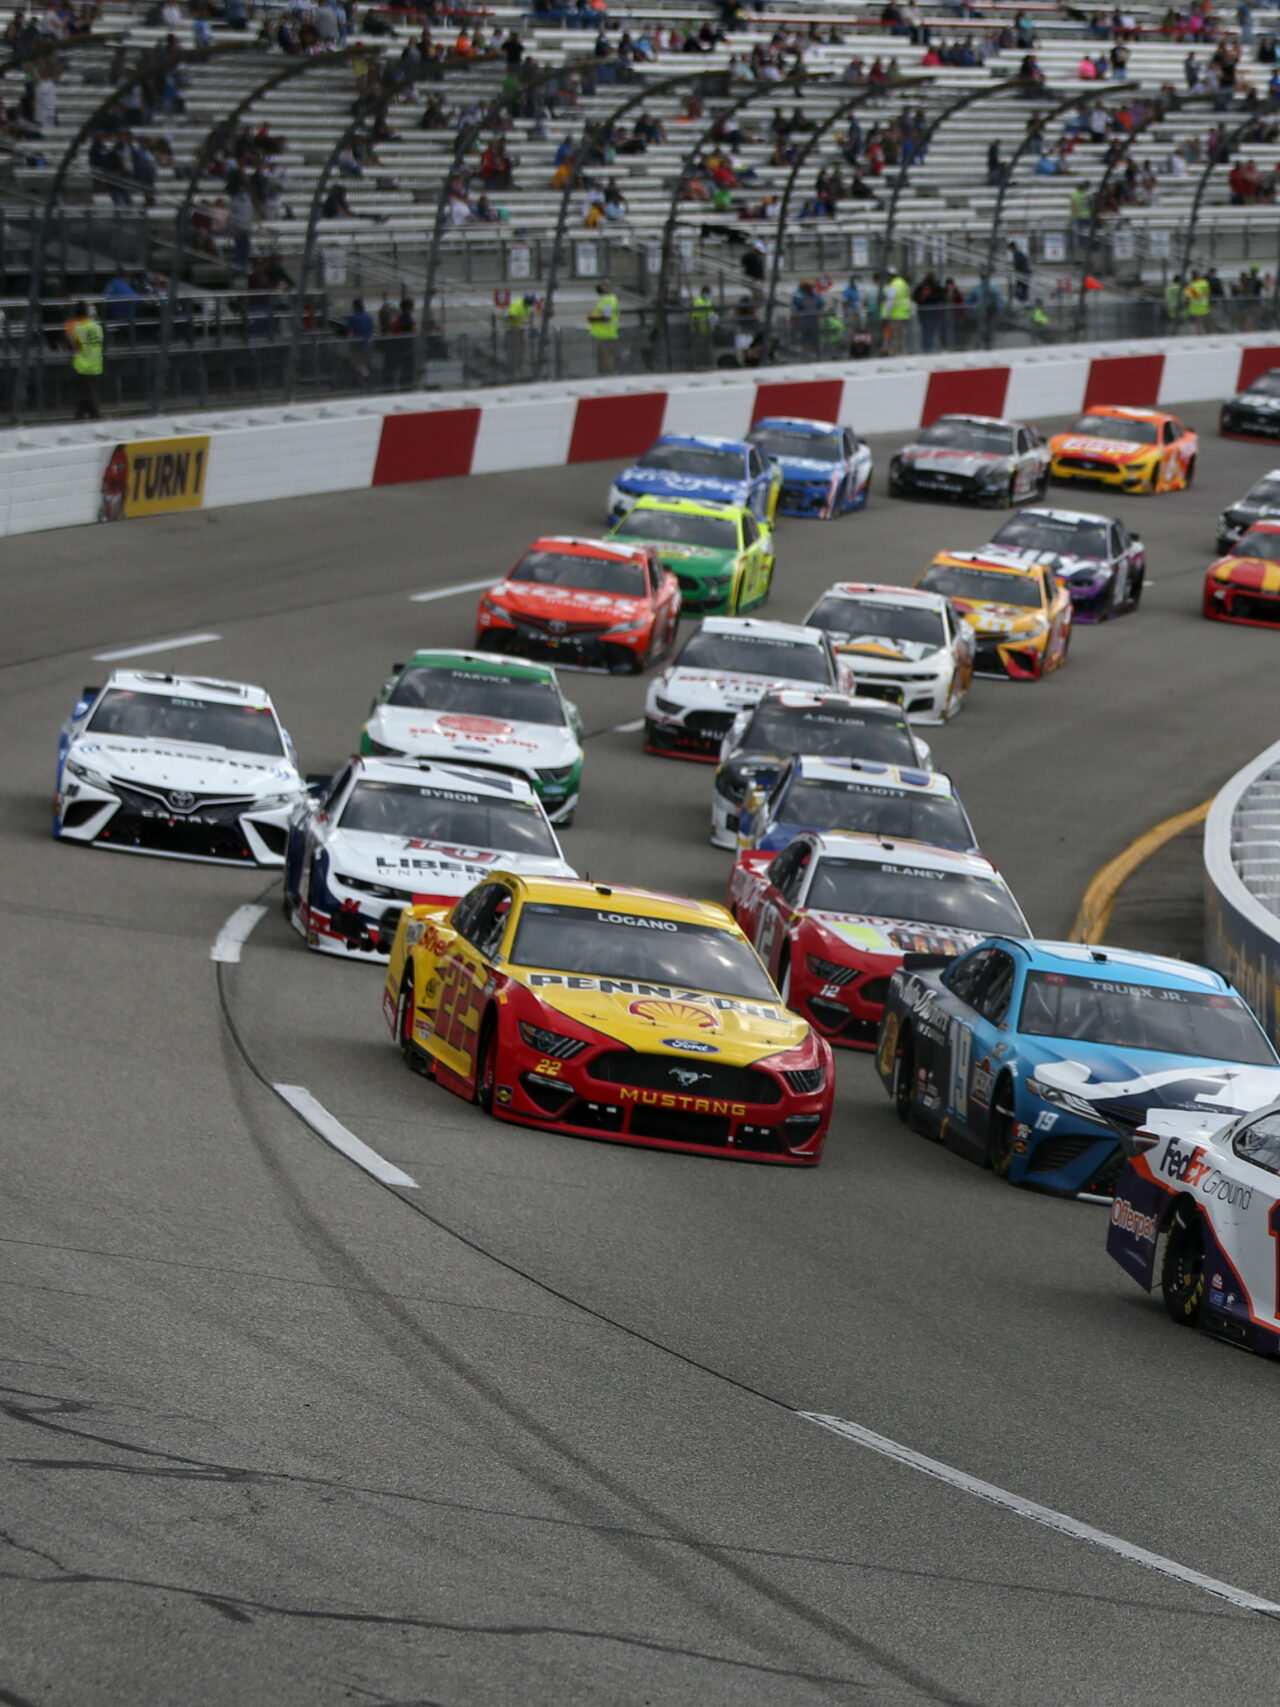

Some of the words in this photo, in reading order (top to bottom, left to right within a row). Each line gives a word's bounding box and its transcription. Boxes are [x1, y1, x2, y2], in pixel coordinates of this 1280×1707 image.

[132, 452, 191, 501] TURN
[193, 450, 204, 495] 1
[452, 670, 511, 685] HARVICK
[420, 787, 479, 804] BYRON
[847, 784, 907, 799] ELLIOTT
[881, 863, 946, 881] BLANEY
[597, 912, 678, 932] LOGANO
[819, 983, 842, 998] 12
[1088, 980, 1154, 998] TRUEX
[1159, 990, 1188, 1003] JR.
[670, 1038, 709, 1053] Ford
[534, 1058, 563, 1076] 22
[946, 1015, 972, 1123] 19
[619, 1087, 747, 1117] MUSTANG
[1034, 1110, 1060, 1131] 19
[1159, 1136, 1213, 1188] FedEx
[1202, 1168, 1255, 1211] Ground
[1111, 1197, 1158, 1244] Offerpad
